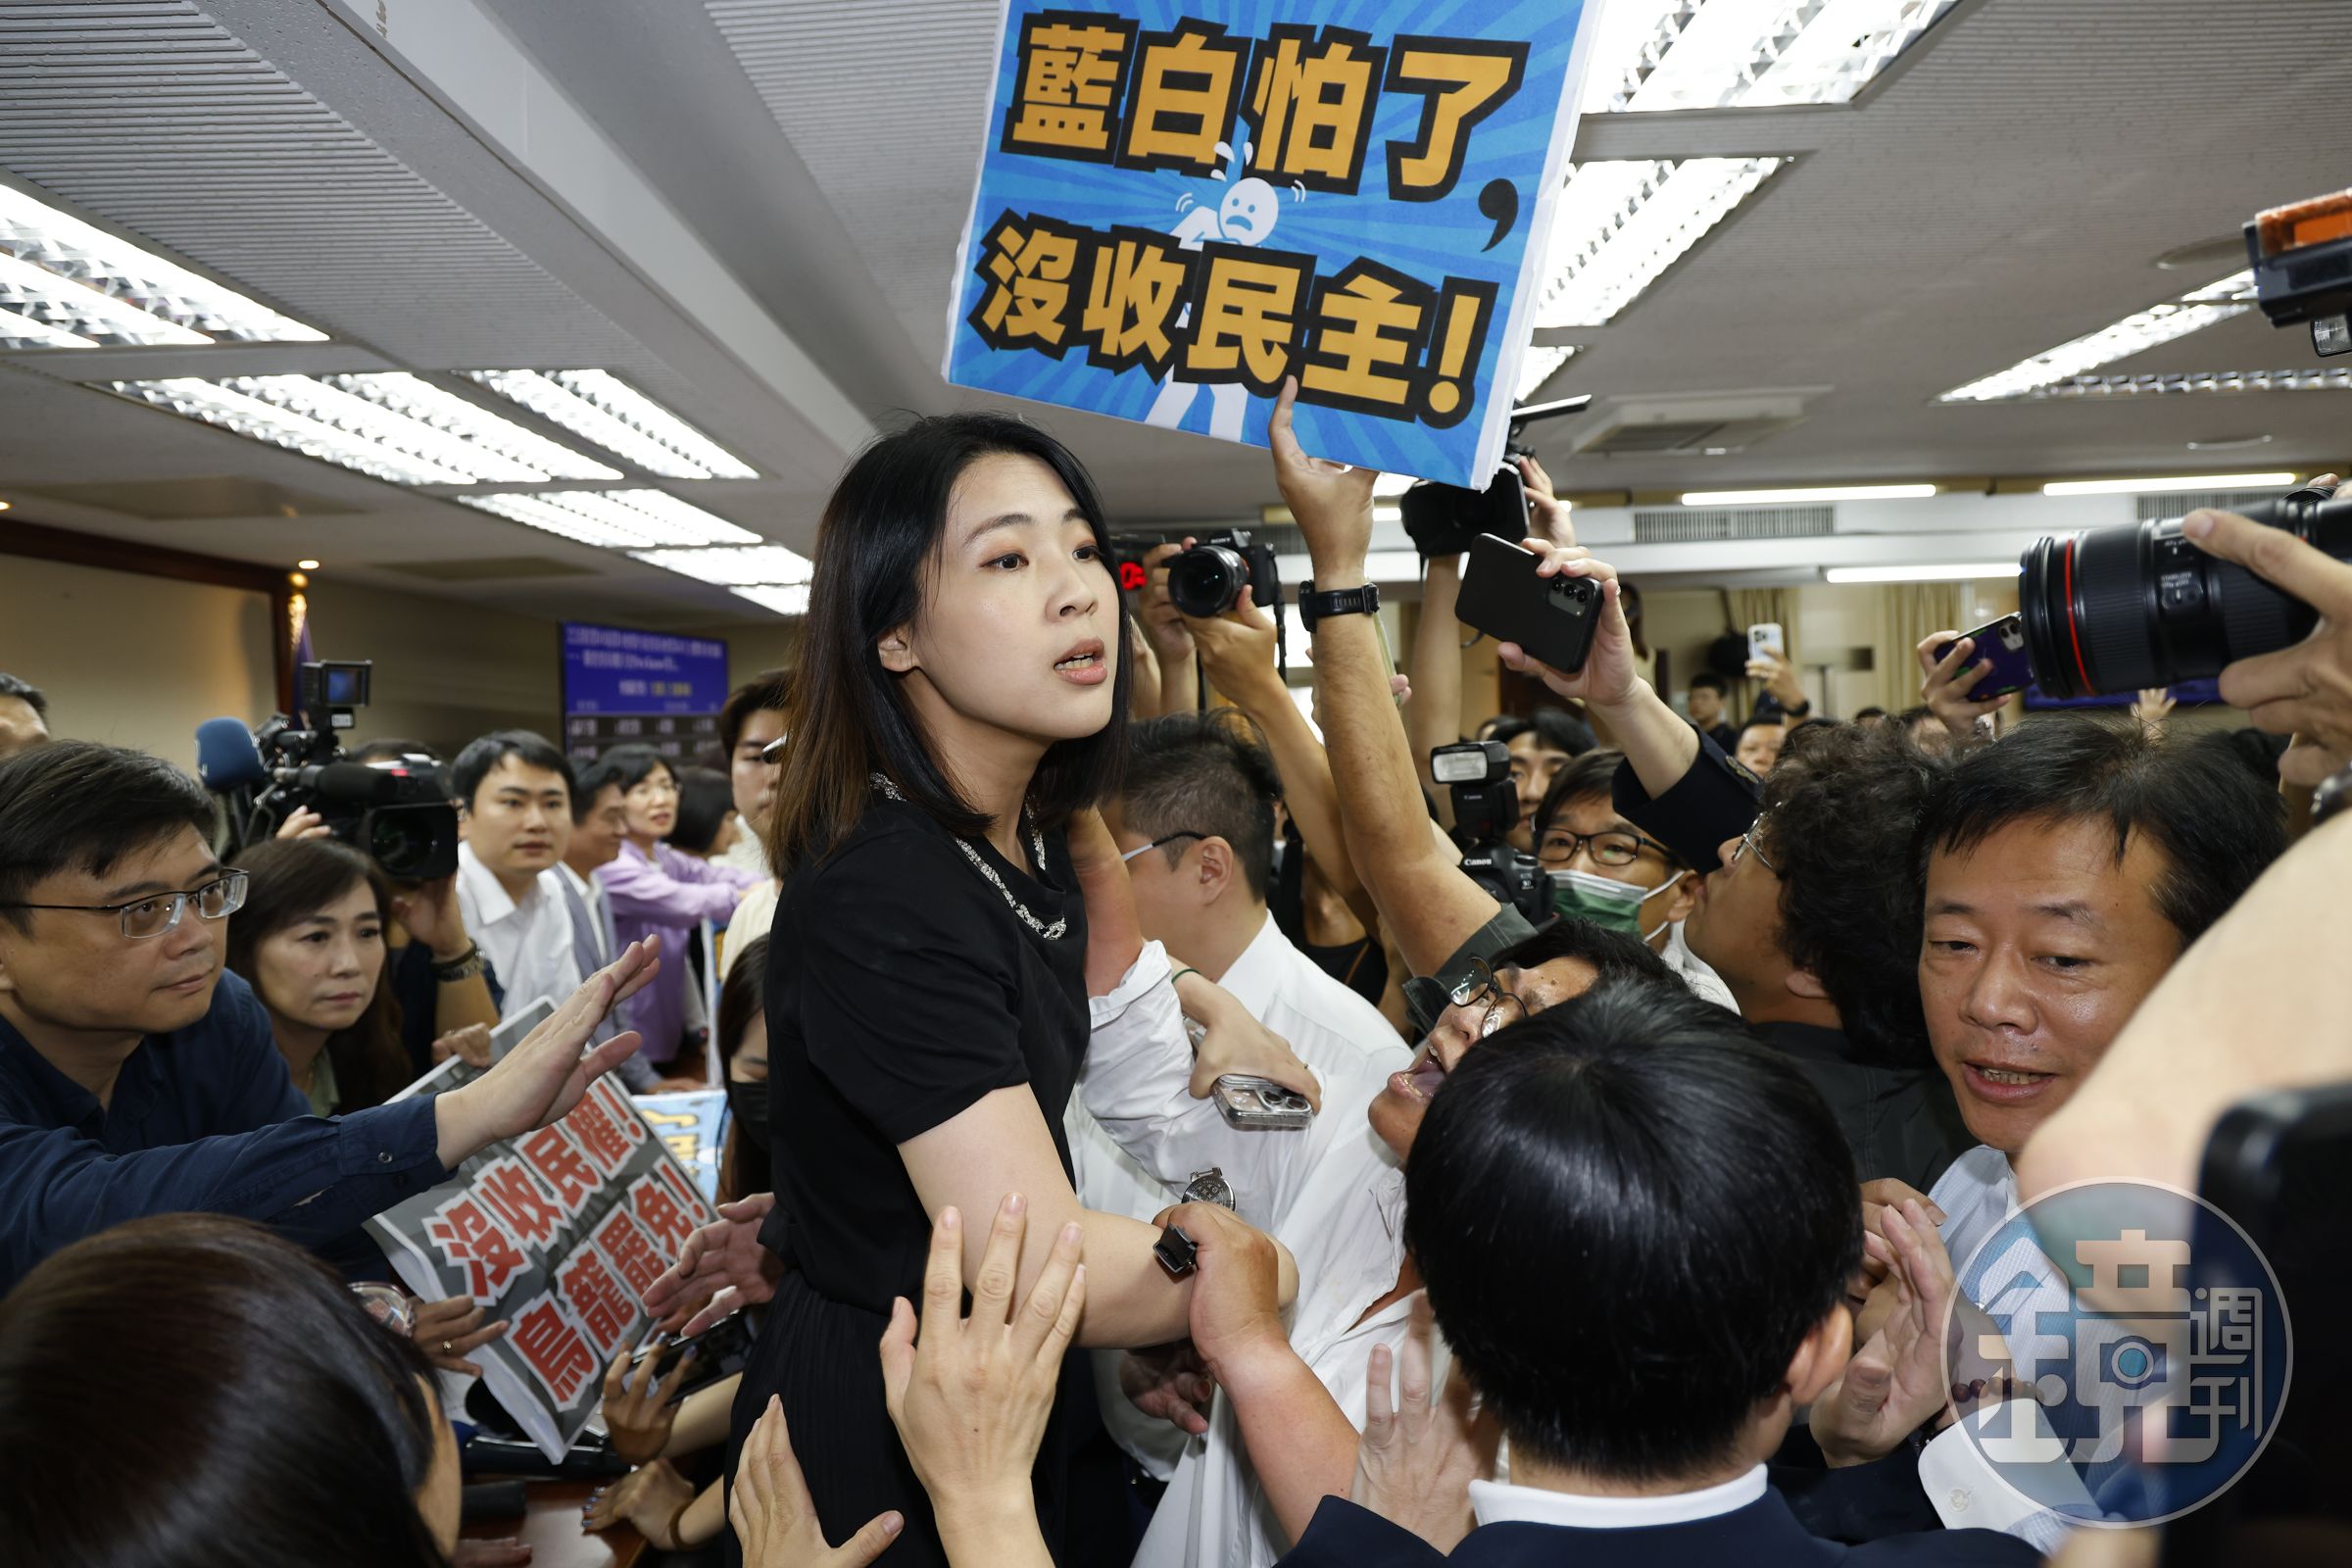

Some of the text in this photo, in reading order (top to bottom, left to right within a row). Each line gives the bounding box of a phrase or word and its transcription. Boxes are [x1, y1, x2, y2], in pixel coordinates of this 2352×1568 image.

[978, 221, 1484, 416] 沒收民主！
[1210, 536, 1232, 545] SONY
[1464, 858, 1493, 866] Canon
